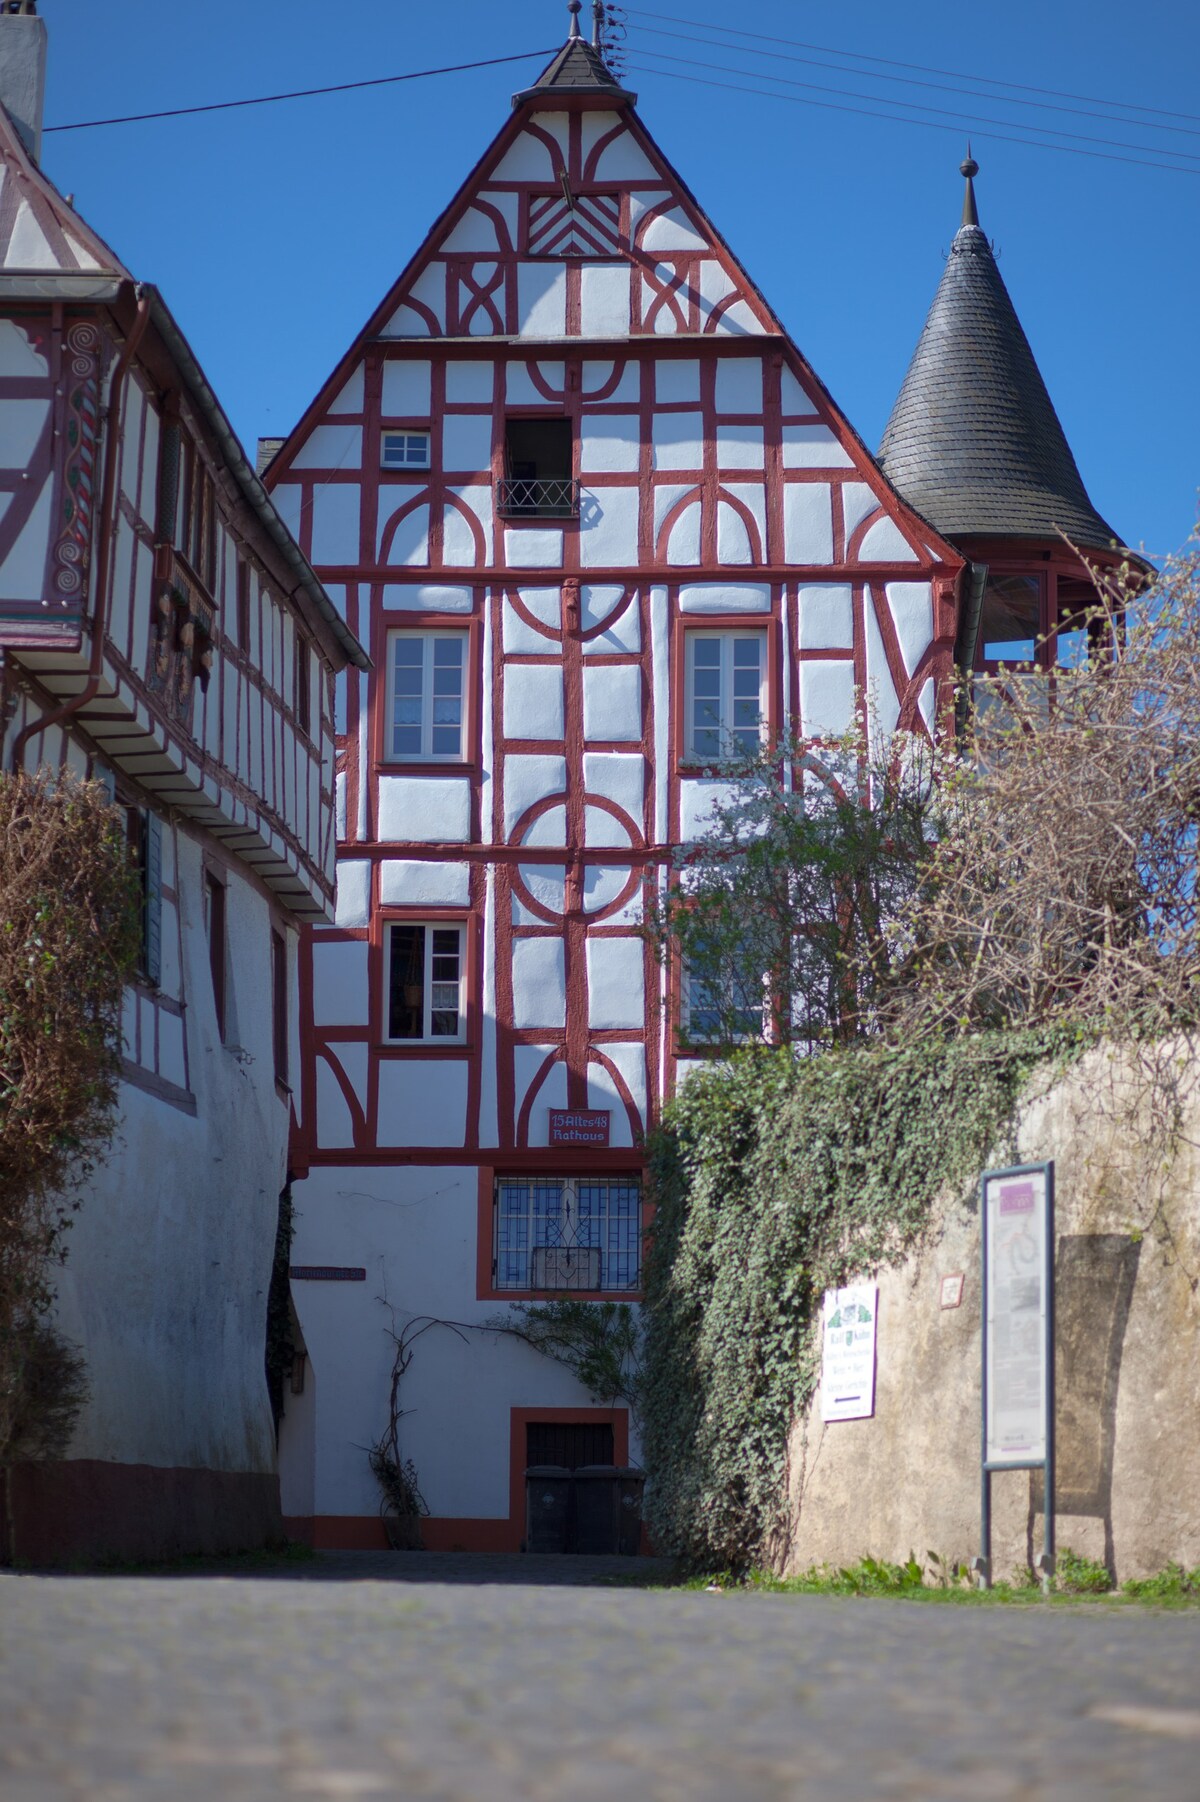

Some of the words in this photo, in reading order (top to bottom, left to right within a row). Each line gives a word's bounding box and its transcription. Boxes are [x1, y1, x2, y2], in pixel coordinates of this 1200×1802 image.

[552, 1114, 564, 1127] 15
[565, 1115, 594, 1127] Altes
[595, 1116, 607, 1128] 48
